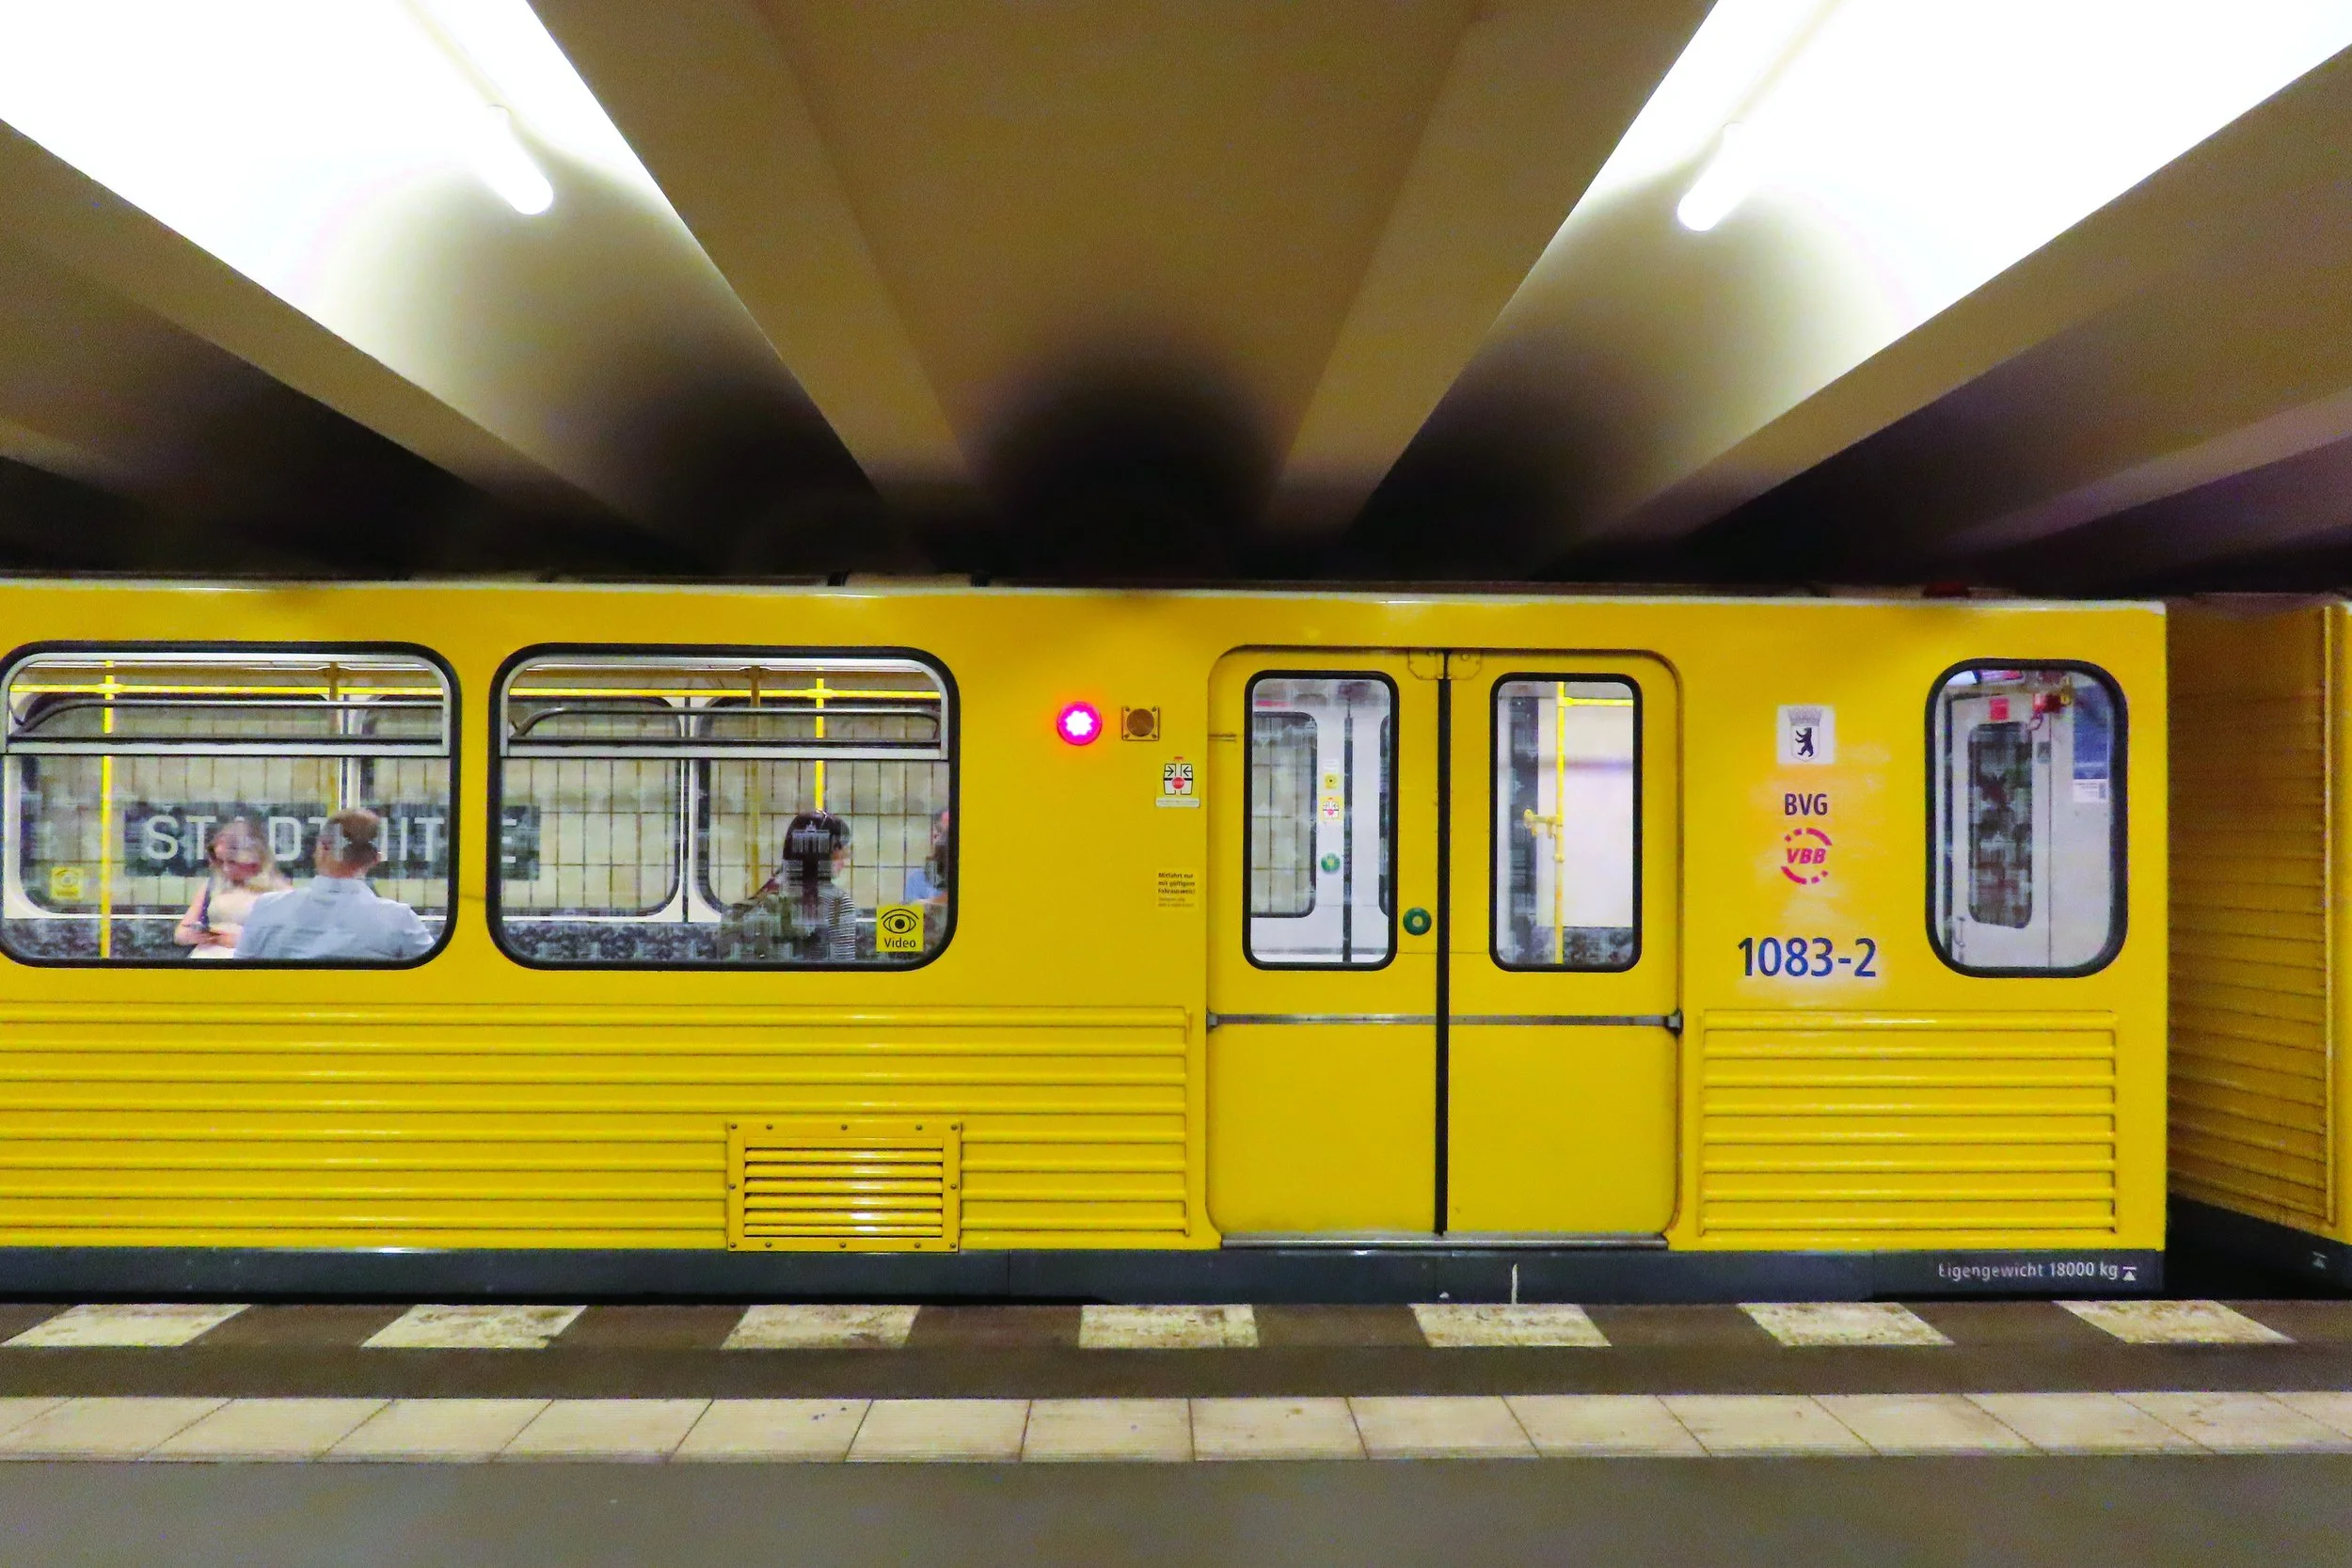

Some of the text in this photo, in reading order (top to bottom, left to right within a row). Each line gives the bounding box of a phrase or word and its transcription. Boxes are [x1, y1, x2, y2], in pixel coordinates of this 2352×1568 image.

[1784, 793, 1828, 816] BVG
[1786, 847, 1827, 864] VBB
[884, 937, 916, 948] Video
[1738, 936, 1877, 977] 1083-2
[1938, 1261, 2118, 1281] Eigengewicht 18000 kg
